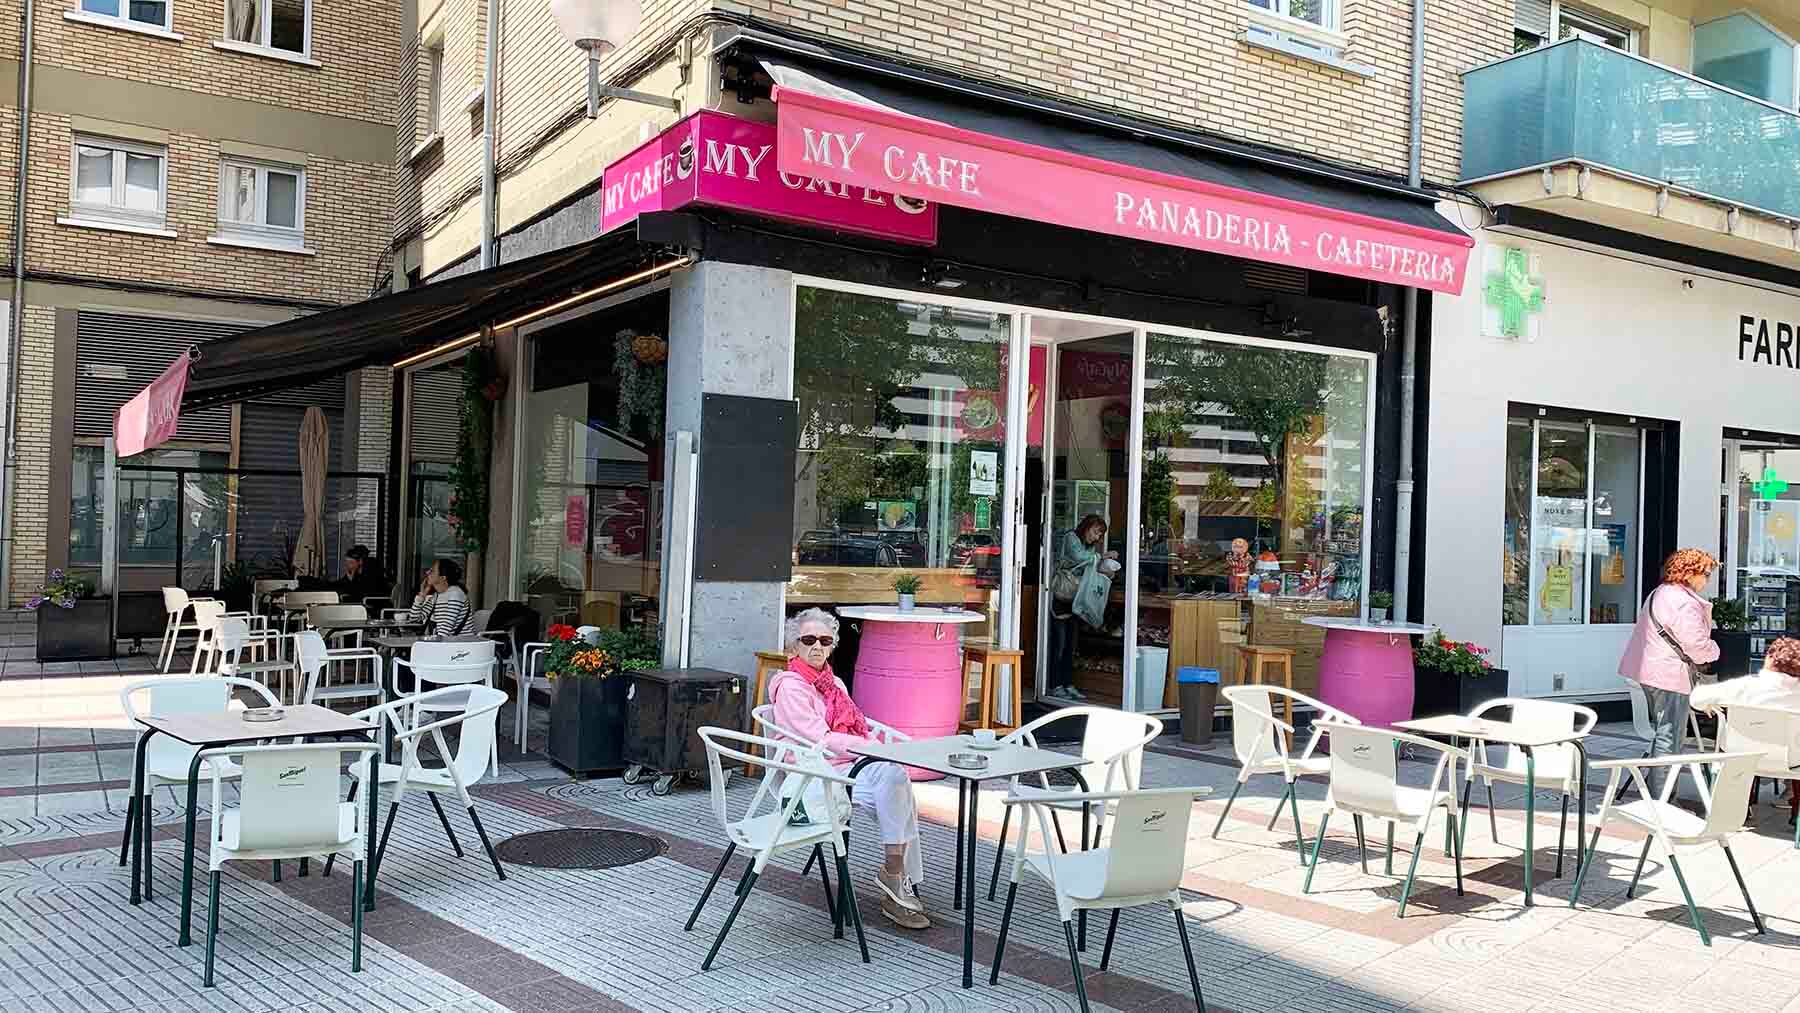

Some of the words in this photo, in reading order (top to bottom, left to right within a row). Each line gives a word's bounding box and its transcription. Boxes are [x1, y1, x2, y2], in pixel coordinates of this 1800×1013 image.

[605, 171, 629, 216] MY
[630, 152, 674, 203] CAFE
[703, 139, 774, 181] MY
[802, 127, 865, 171] MY
[883, 146, 982, 197] CAFE
[1114, 191, 1292, 255] PANADERIA
[1316, 231, 1456, 284] CAFETERIA
